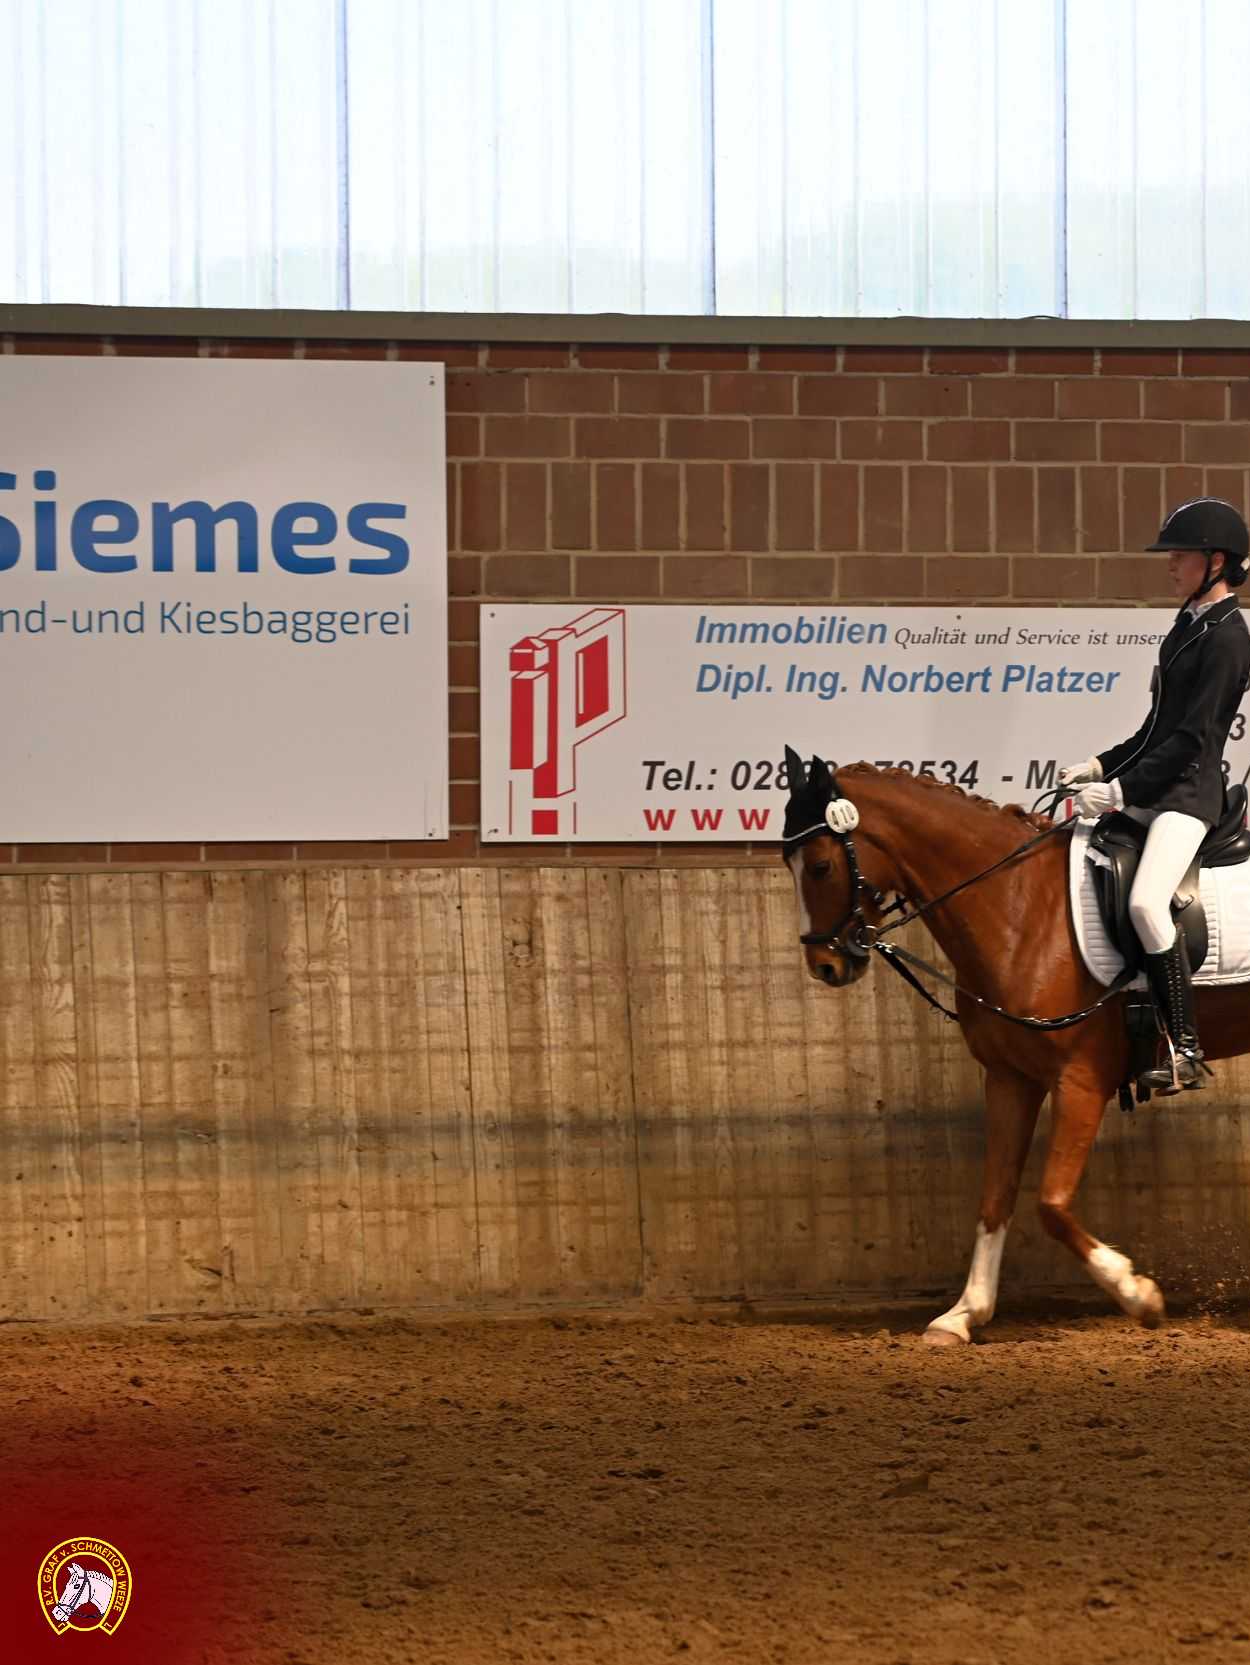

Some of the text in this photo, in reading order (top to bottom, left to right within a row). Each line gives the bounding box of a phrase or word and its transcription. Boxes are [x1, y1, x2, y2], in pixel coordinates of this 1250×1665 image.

[0, 470, 410, 576] iemes
[160, 601, 410, 644] Kiesbaggerei
[696, 615, 888, 645] Immobilien
[894, 626, 967, 650] Qualität
[974, 626, 1010, 645] und
[1016, 628, 1081, 645] Service
[1087, 629, 1109, 645] ist
[696, 663, 773, 700] Dipl.
[785, 664, 847, 700] Ing.
[861, 664, 993, 693] Norbert
[1001, 664, 1121, 693] Platzer
[642, 760, 717, 791] Tel.:
